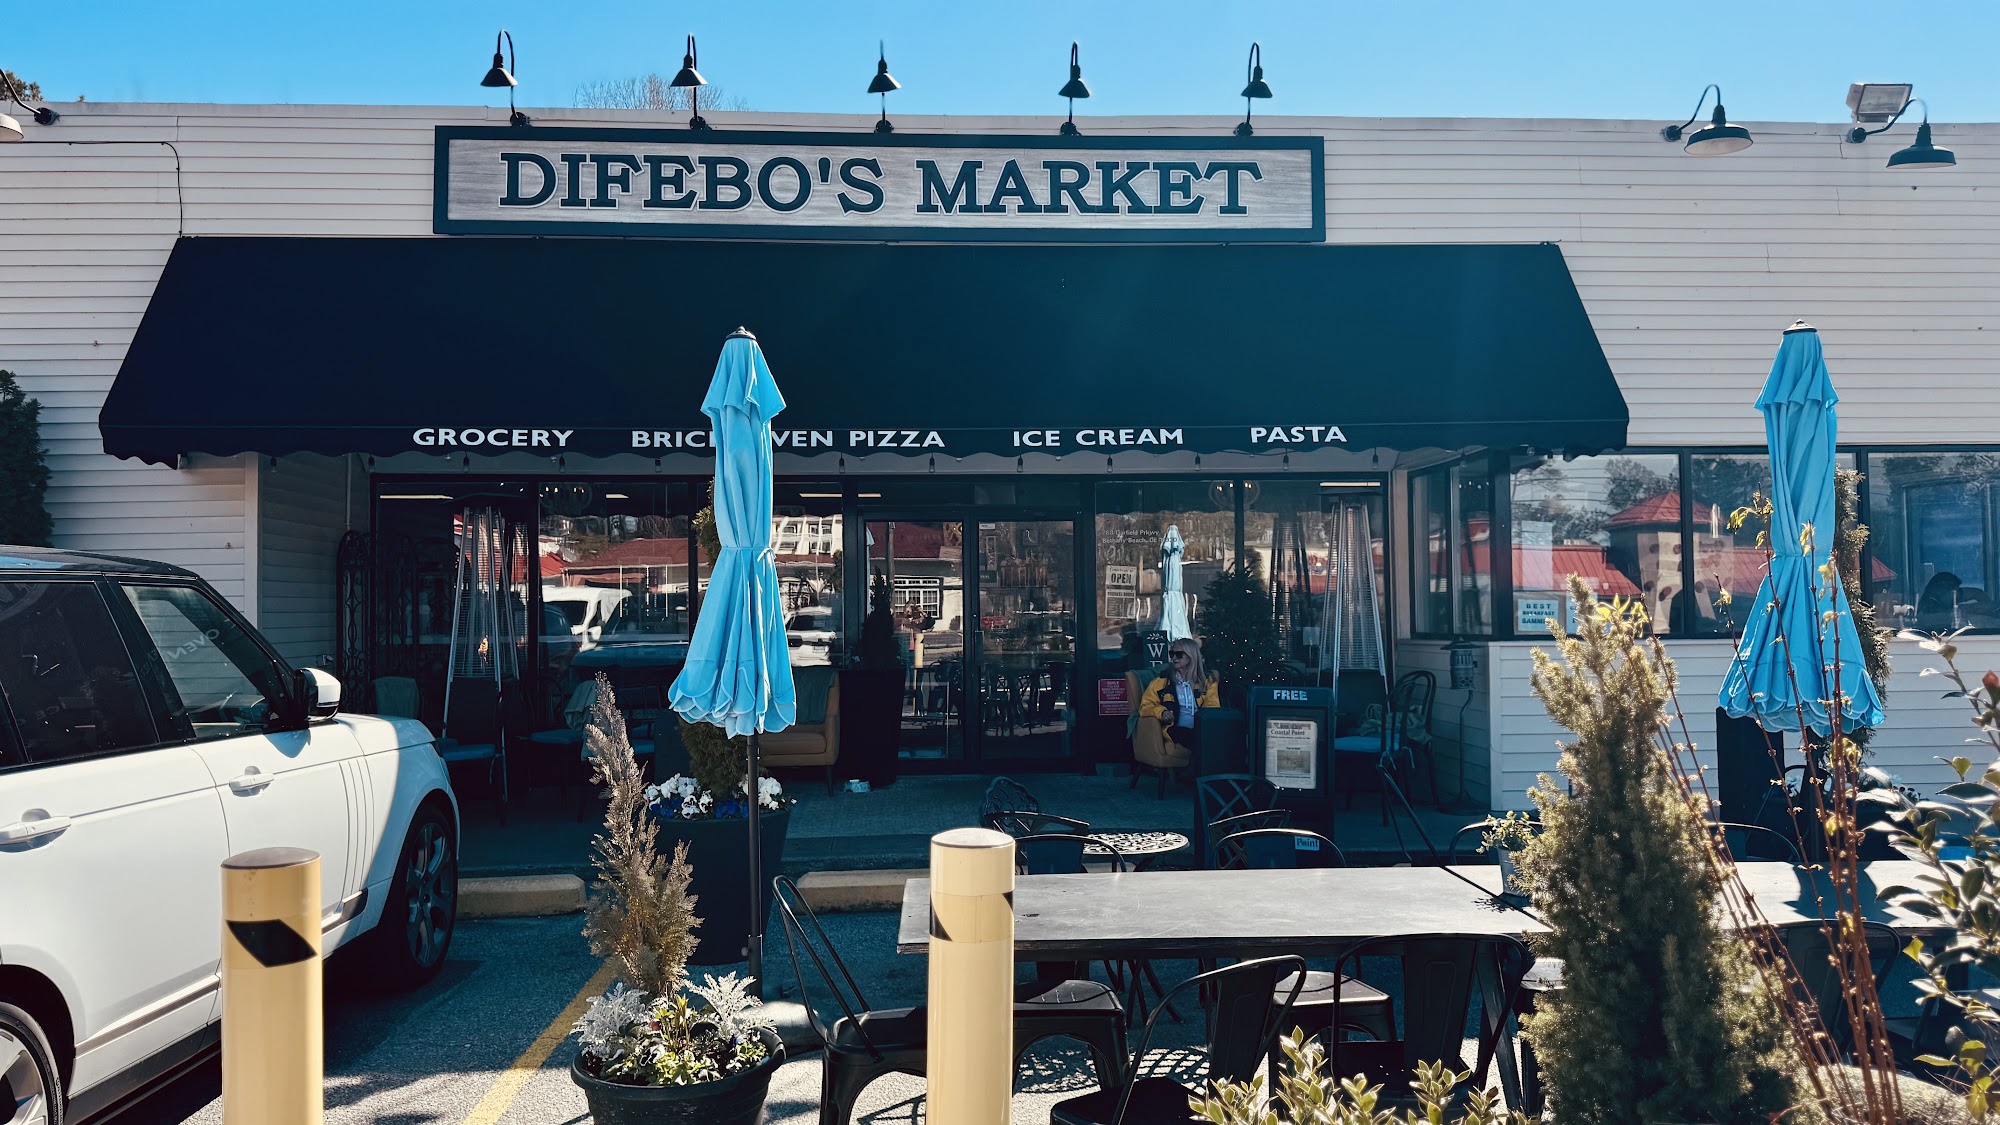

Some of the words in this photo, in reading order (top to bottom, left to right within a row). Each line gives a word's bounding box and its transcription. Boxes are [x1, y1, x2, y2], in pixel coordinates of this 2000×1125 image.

[498, 152, 885, 214] DIFEBO'S
[915, 159, 1263, 214] MARKET
[413, 429, 574, 447] GROCERY
[632, 431, 716, 448] BRIC
[771, 431, 833, 447] VEN
[850, 430, 945, 448] PIZZA
[1014, 430, 1061, 447] ICE
[1076, 429, 1184, 446] CREAM
[1250, 426, 1347, 443] PASTA
[1111, 573, 1132, 584] OPEN
[1273, 689, 1308, 701] FREE
[1297, 838, 1319, 848] Point
